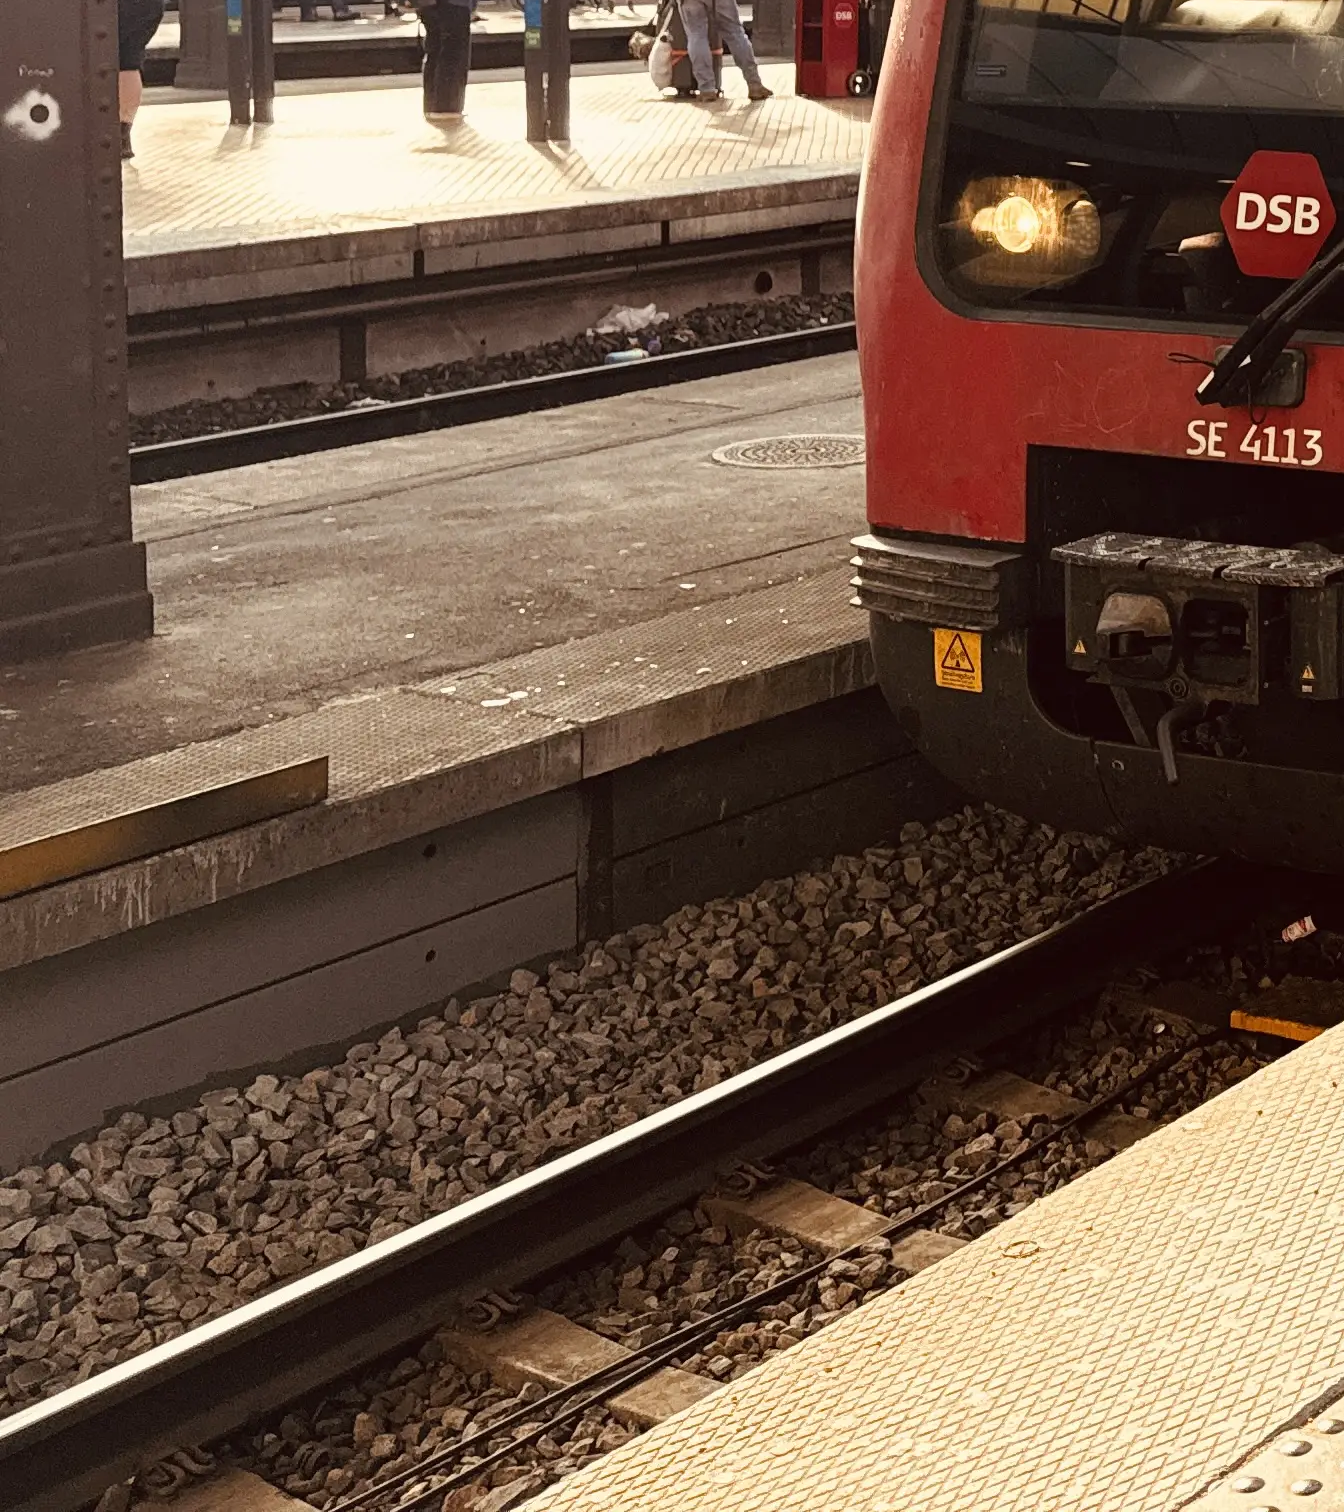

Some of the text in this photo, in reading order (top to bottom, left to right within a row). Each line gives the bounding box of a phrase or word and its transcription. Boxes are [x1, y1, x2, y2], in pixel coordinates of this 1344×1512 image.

[835, 11, 853, 21] DSB
[1235, 191, 1321, 236] DSB
[1186, 419, 1323, 467] SE 4113
